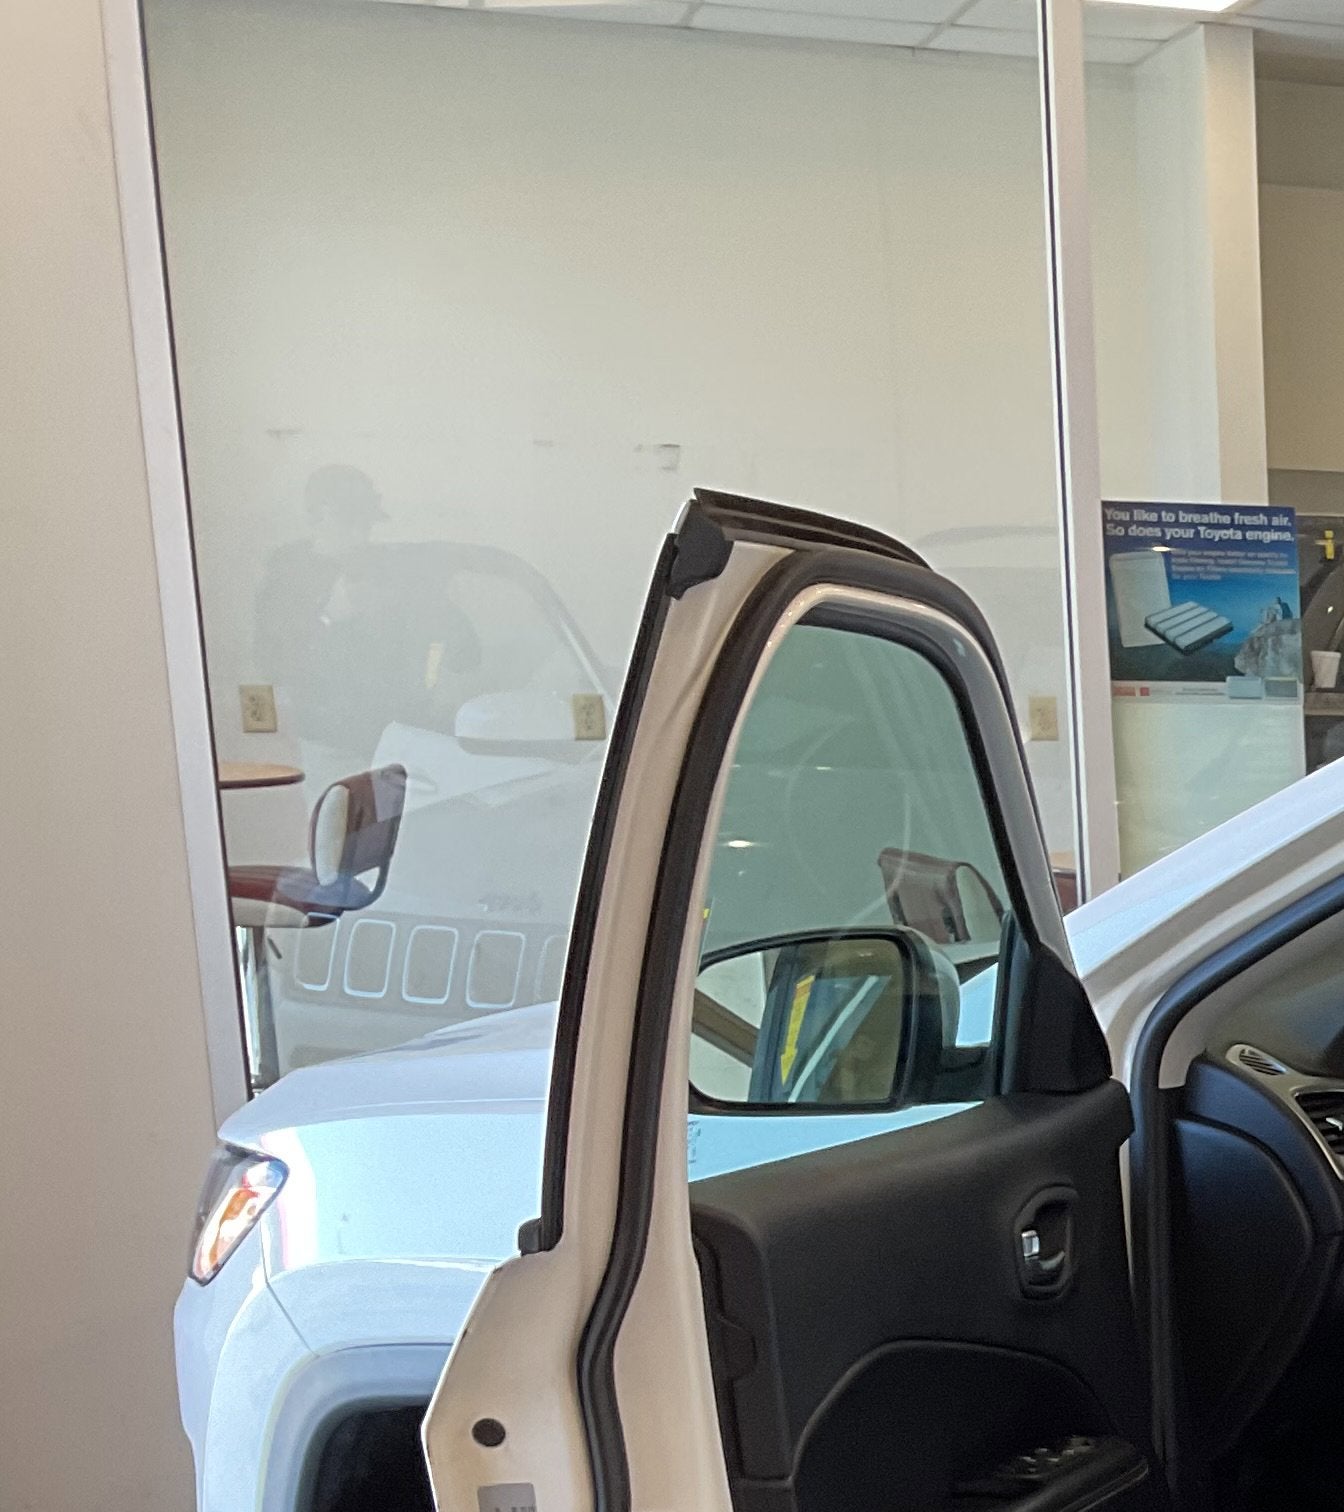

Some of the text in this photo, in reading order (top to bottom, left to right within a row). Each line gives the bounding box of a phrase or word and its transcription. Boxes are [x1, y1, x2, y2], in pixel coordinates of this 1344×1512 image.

[1104, 508, 1292, 527] You like to breathe fresh air.
[1106, 524, 1295, 544] So does your Toyota engine.
